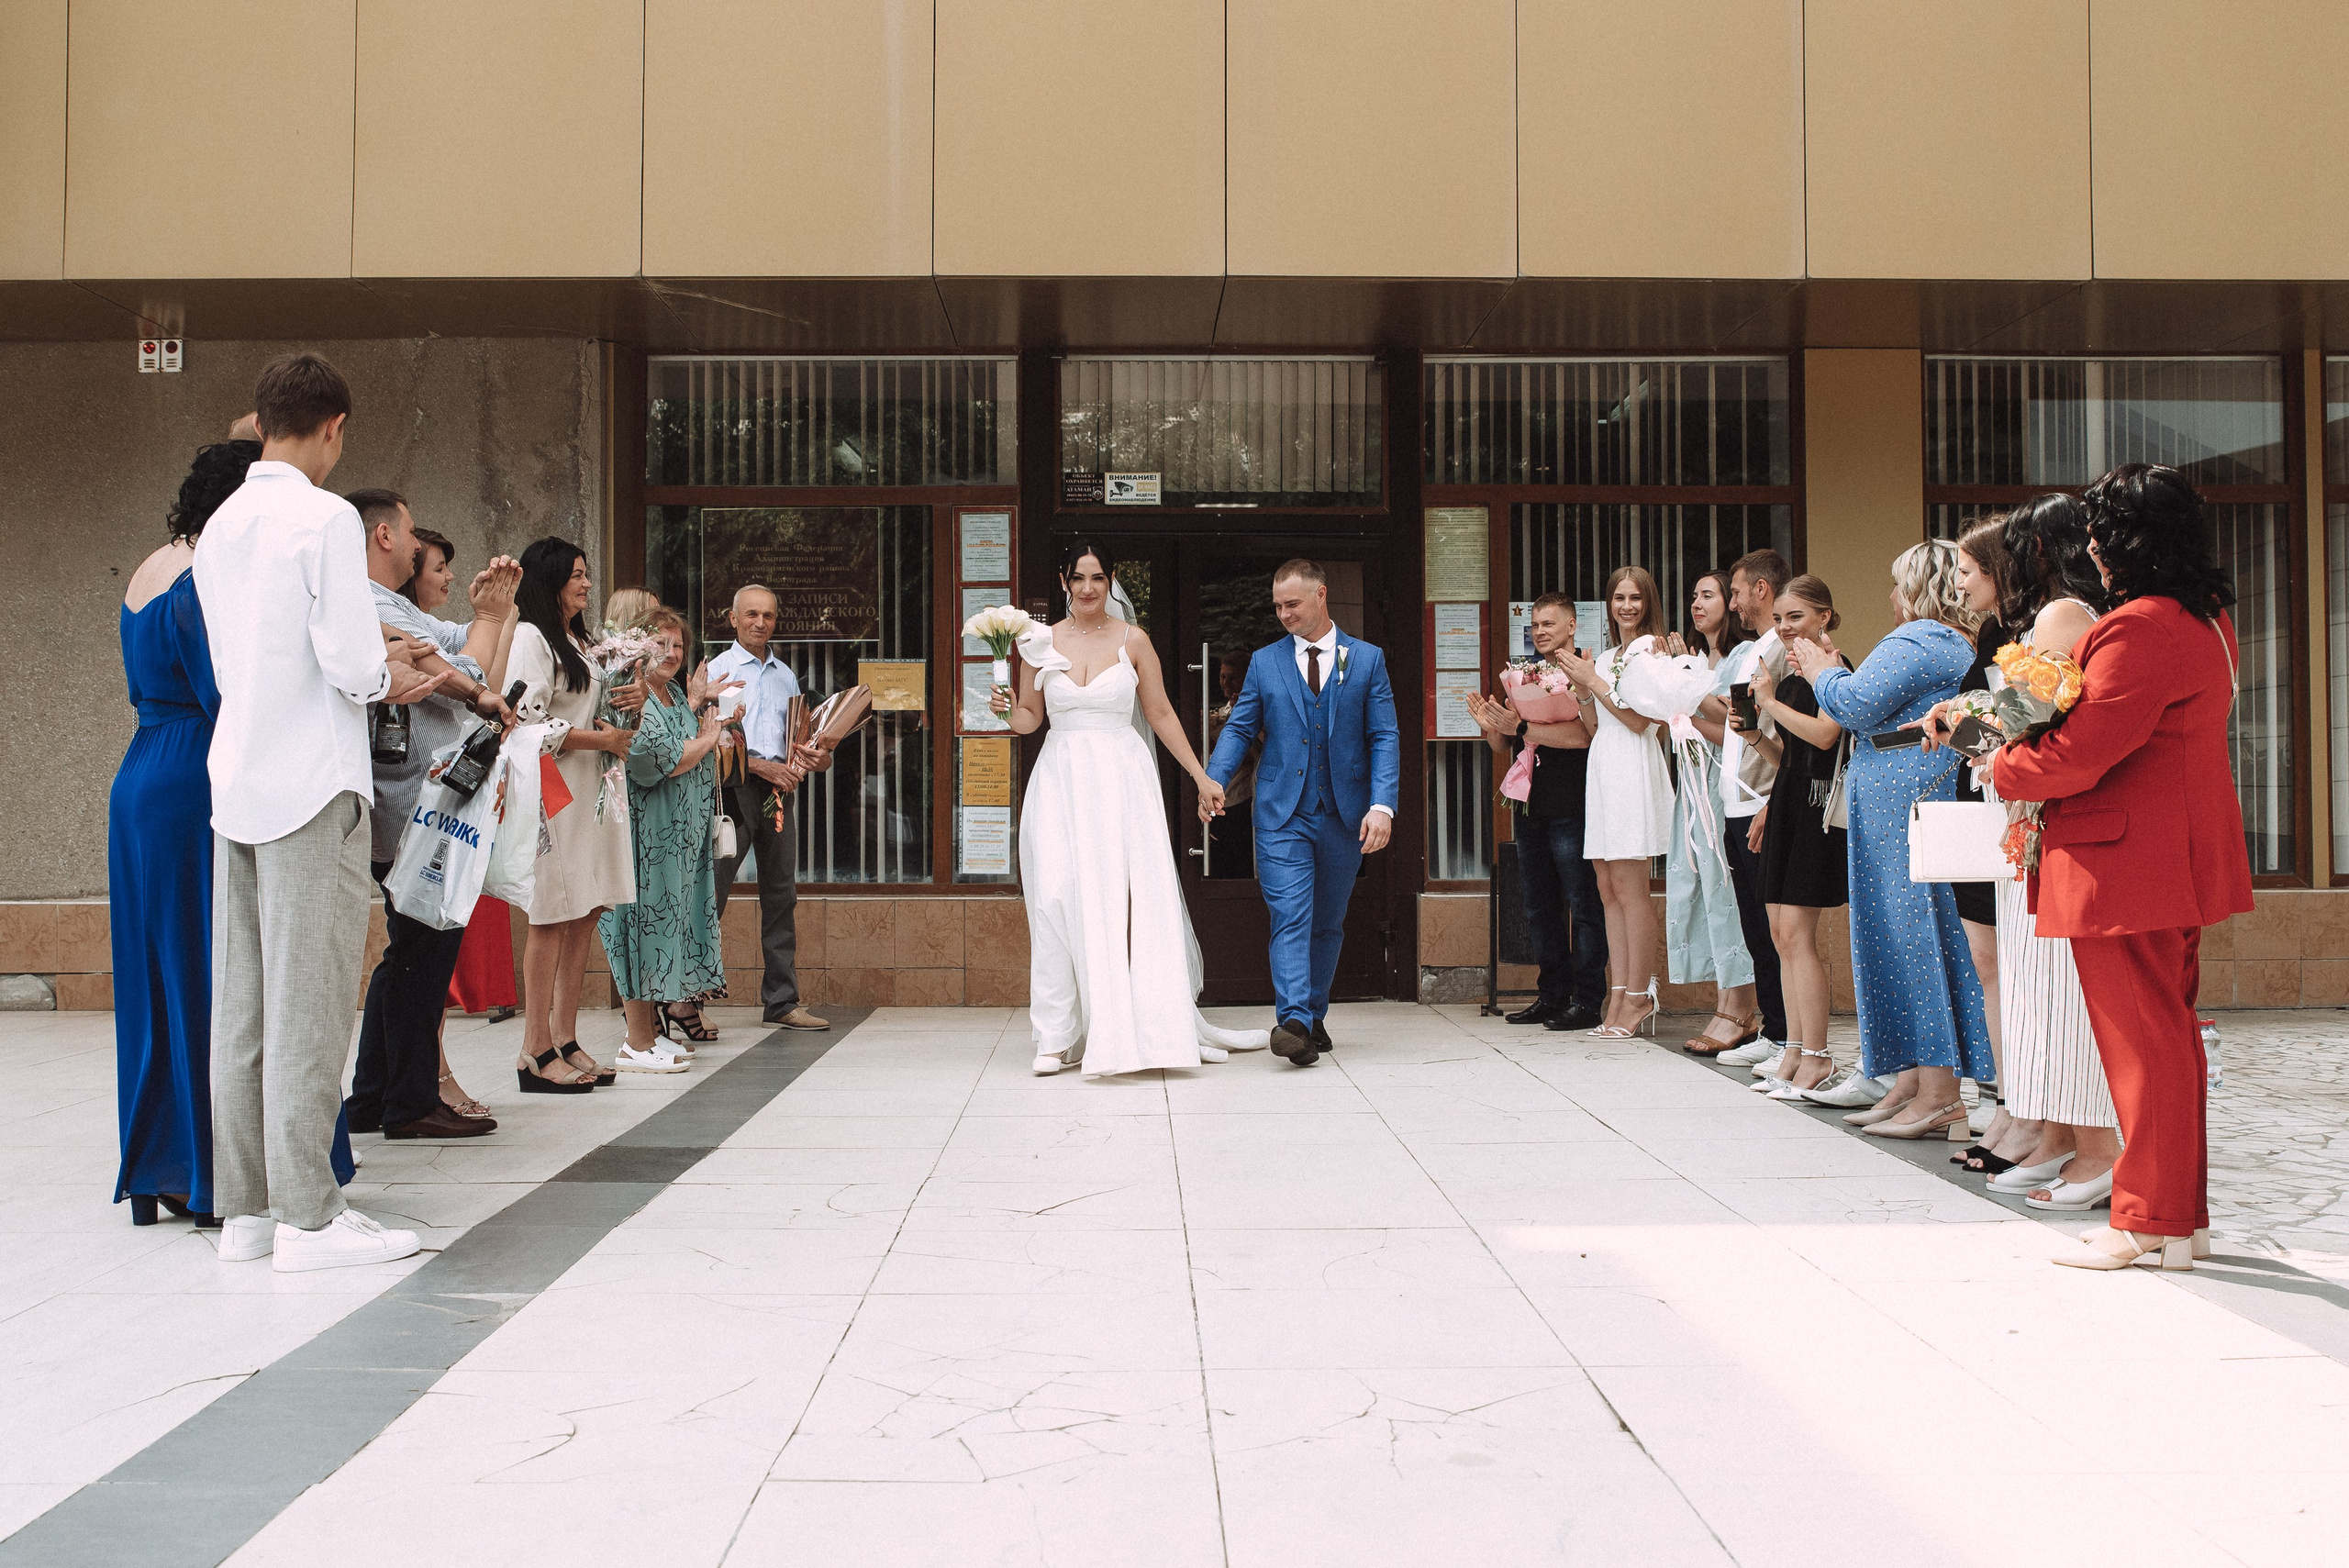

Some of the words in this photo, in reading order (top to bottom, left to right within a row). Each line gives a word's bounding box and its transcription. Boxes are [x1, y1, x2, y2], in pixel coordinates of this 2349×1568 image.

[753, 553, 825, 562] Администрация
[818, 564, 850, 573] района
[787, 593, 849, 605] ЗАПИСИ
[776, 620, 836, 631] ТОЯНИЯ
[413, 806, 437, 828] LC
